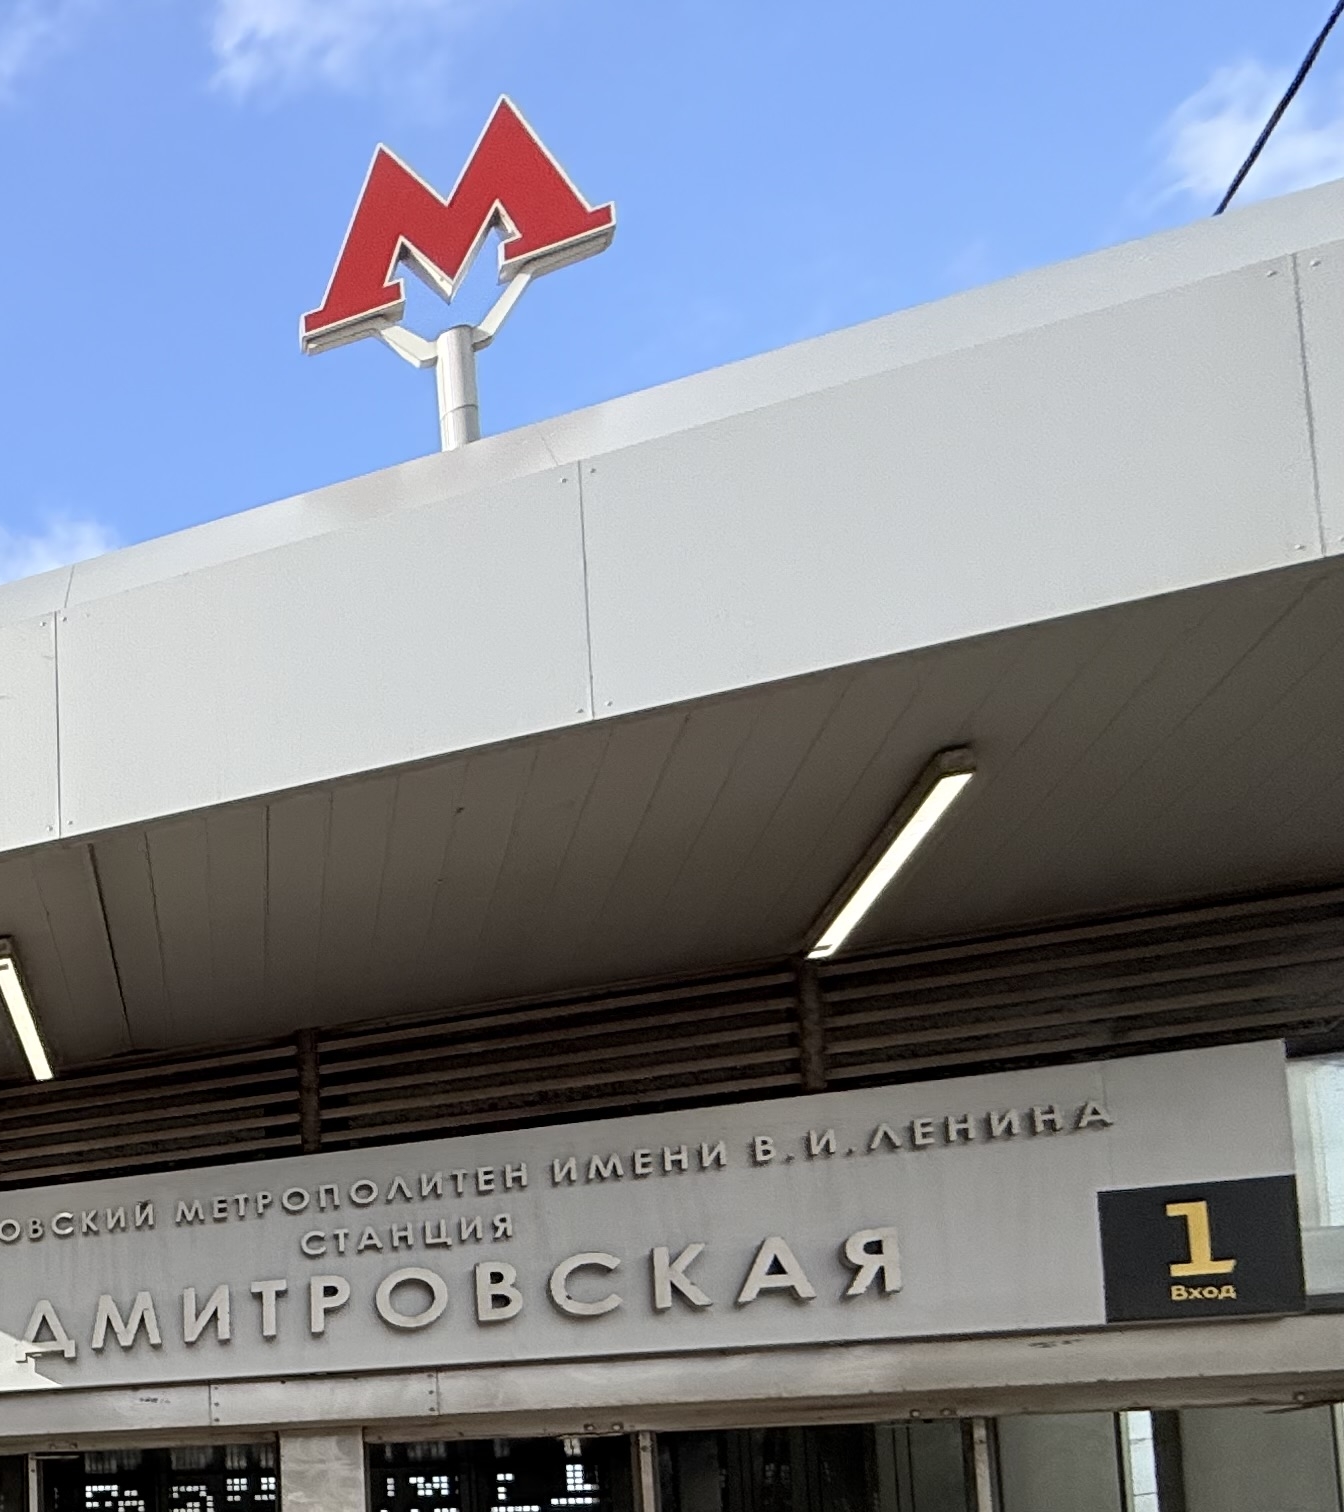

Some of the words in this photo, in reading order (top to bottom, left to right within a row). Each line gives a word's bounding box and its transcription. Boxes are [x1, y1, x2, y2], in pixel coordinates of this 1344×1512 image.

[175, 1160, 528, 1225] МЕТРОПОЛИТЕН
[552, 1141, 727, 1186] ИМЕНИ
[300, 1212, 513, 1257] СТАНЦИЯ
[1166, 1200, 1237, 1277] 1
[16, 1226, 903, 1363] ДМИТРОВСКАЯ
[1170, 1284, 1237, 1301] Вход
